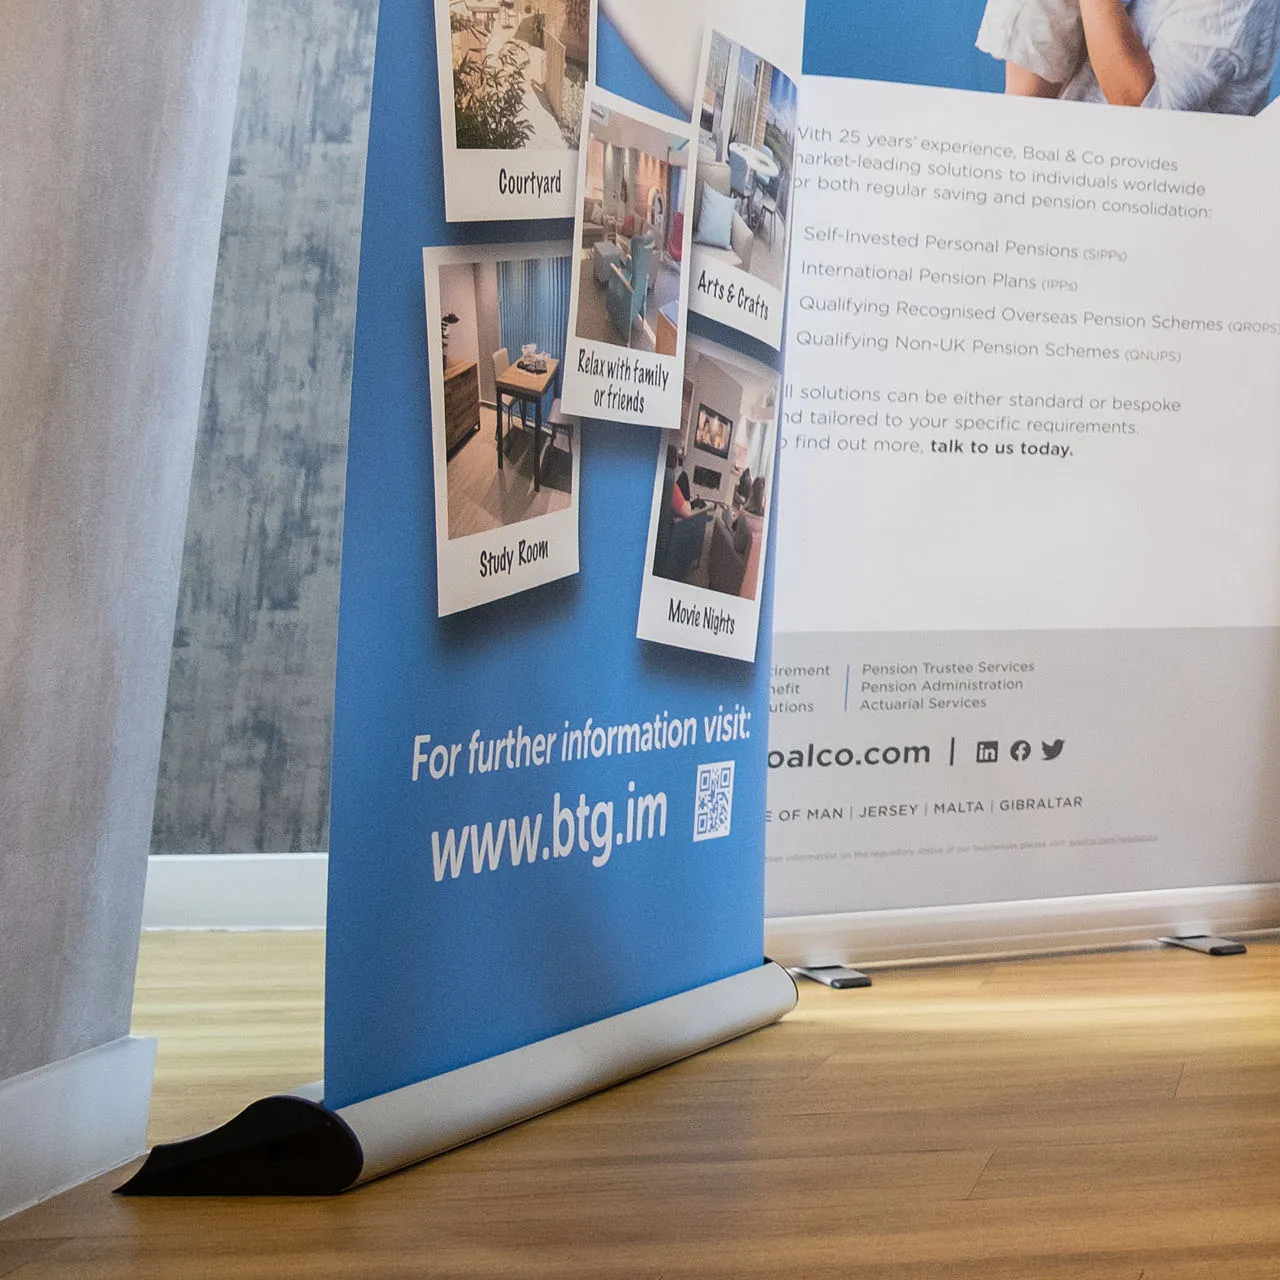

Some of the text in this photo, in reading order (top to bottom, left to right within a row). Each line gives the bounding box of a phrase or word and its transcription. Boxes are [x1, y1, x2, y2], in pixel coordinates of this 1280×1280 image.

[839, 128, 860, 144] 25
[1023, 145, 1060, 161] Boal
[1065, 149, 1077, 163] &
[1081, 150, 1105, 165] Co
[1110, 154, 1178, 172] provides
[498, 167, 562, 197] Courtyard
[928, 161, 1003, 180] solutions
[1009, 169, 1026, 183] to
[1032, 170, 1118, 190] individuals
[1123, 179, 1206, 196] worldwide
[818, 176, 859, 192] both
[866, 181, 927, 198] regular
[933, 187, 987, 205] saving
[993, 192, 1025, 206] and
[1032, 194, 1096, 210] pension
[1102, 198, 1212, 219] consolidation:
[803, 225, 919, 248] Self-Invested
[925, 234, 999, 254] Personal
[1005, 239, 1078, 259] Pensions
[801, 260, 913, 281] International
[919, 267, 986, 286] Pension
[993, 273, 1037, 290] Plans
[696, 273, 770, 322] Arts & Crafts
[799, 294, 890, 317] Qualifying
[896, 300, 996, 321] Recognised
[1001, 306, 1077, 325] Overseas
[1083, 311, 1146, 328] Pension
[1151, 315, 1223, 332] Schemes
[796, 329, 1182, 364] Qualifying Non-UK Pension Schemes (QNUPS)
[576, 348, 670, 393] Relax with family
[593, 387, 646, 414] or friends
[800, 385, 881, 403] solutions
[887, 391, 918, 404] can
[925, 390, 947, 404] be
[953, 391, 1003, 407] either
[1009, 393, 1084, 410] standard
[1089, 398, 1107, 410] or
[1112, 396, 1181, 414] bespoke
[810, 411, 878, 428] tailored
[885, 414, 902, 428] to
[908, 416, 948, 431] your
[954, 415, 1021, 432] specific
[1026, 418, 1140, 436] requirements.
[795, 434, 830, 450] find
[837, 437, 867, 451] out
[930, 438, 964, 453] talk
[971, 440, 989, 454] to
[995, 443, 1014, 455] us
[1021, 441, 1074, 460] today.
[479, 539, 550, 578] Study Room
[667, 597, 736, 637] Movie Nights
[862, 663, 918, 677] Pension
[924, 662, 975, 675] Trustee
[978, 660, 1036, 674] Services
[861, 680, 917, 694] Pension
[921, 678, 1024, 692] Administration
[860, 697, 925, 711] Actuarial
[928, 696, 987, 709] Services
[411, 704, 752, 782] For further information visit:
[779, 796, 1083, 822] OF MAN JERSEY MALTA GIBRALTAR
[430, 780, 667, 882] www.btg.im
